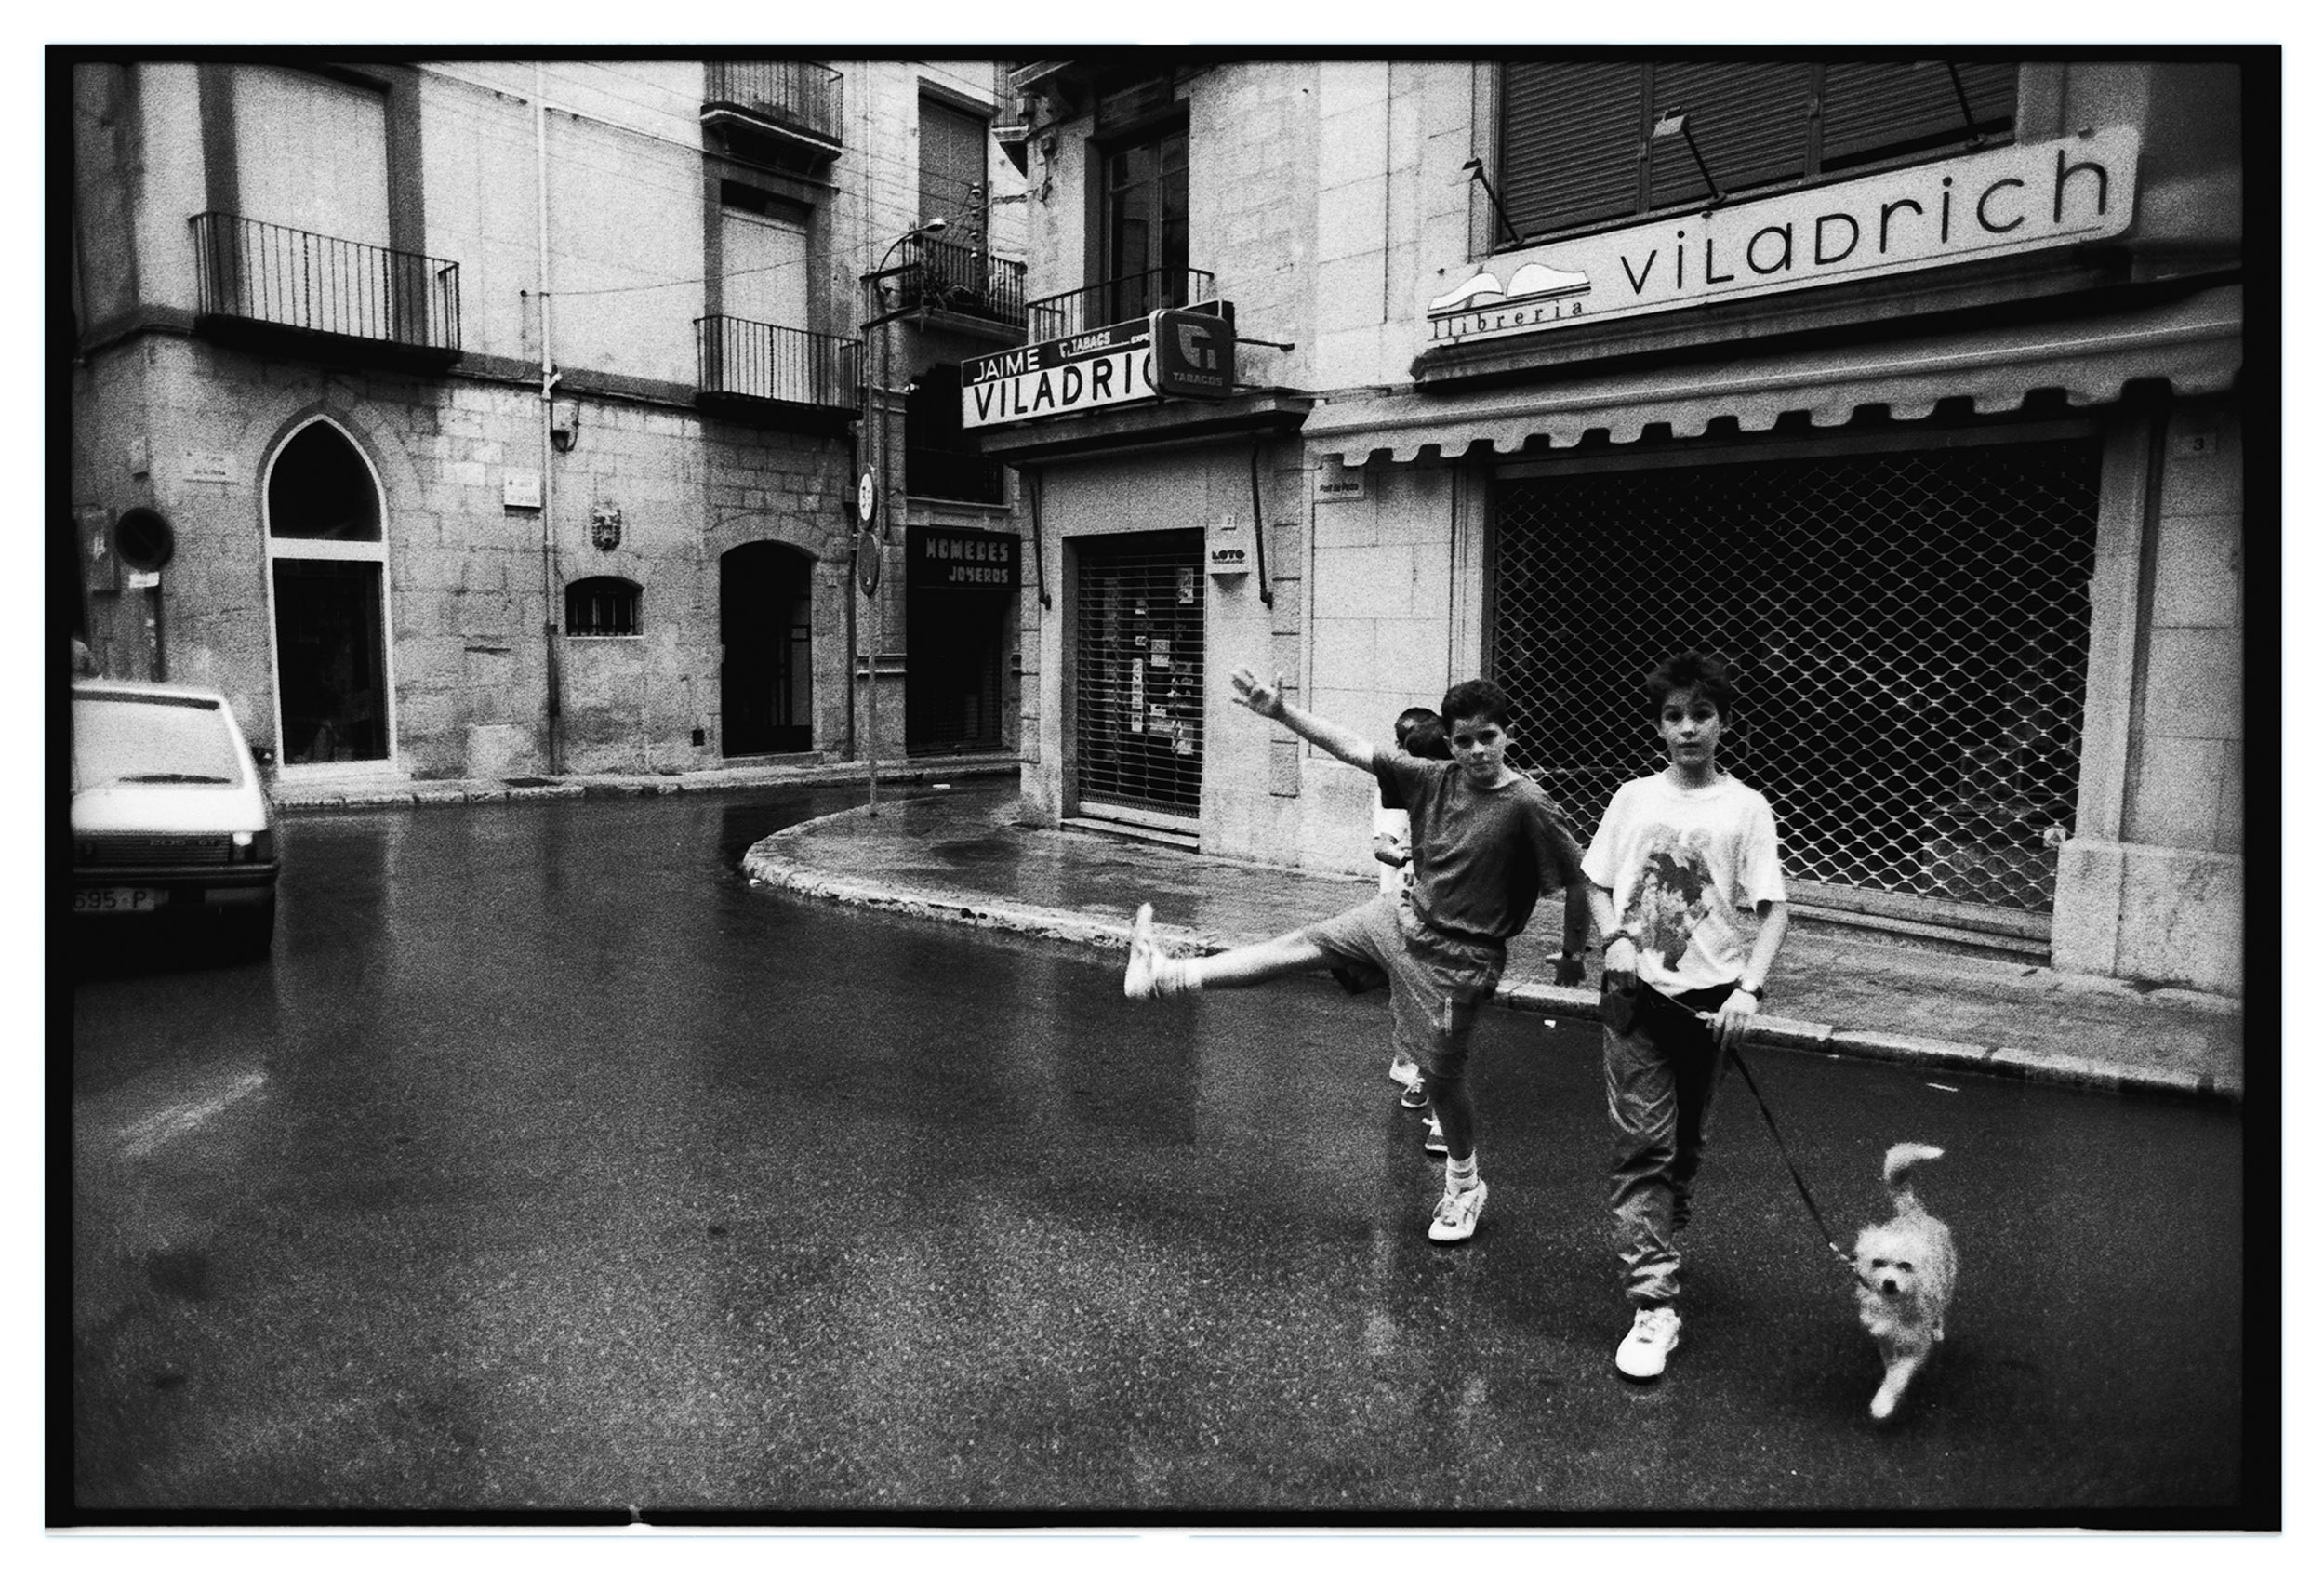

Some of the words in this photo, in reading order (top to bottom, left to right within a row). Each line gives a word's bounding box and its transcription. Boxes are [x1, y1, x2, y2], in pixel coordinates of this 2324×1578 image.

[1432, 299, 1584, 340] llibreria
[1070, 331, 1111, 353] TABACS
[974, 348, 1040, 383] JAIME
[1173, 372, 1223, 387] TABACOS
[2193, 437, 2204, 451] 3
[926, 537, 1009, 562] HOMEDES
[1211, 550, 1245, 560] LOTO
[949, 566, 1009, 584] JOYEROS
